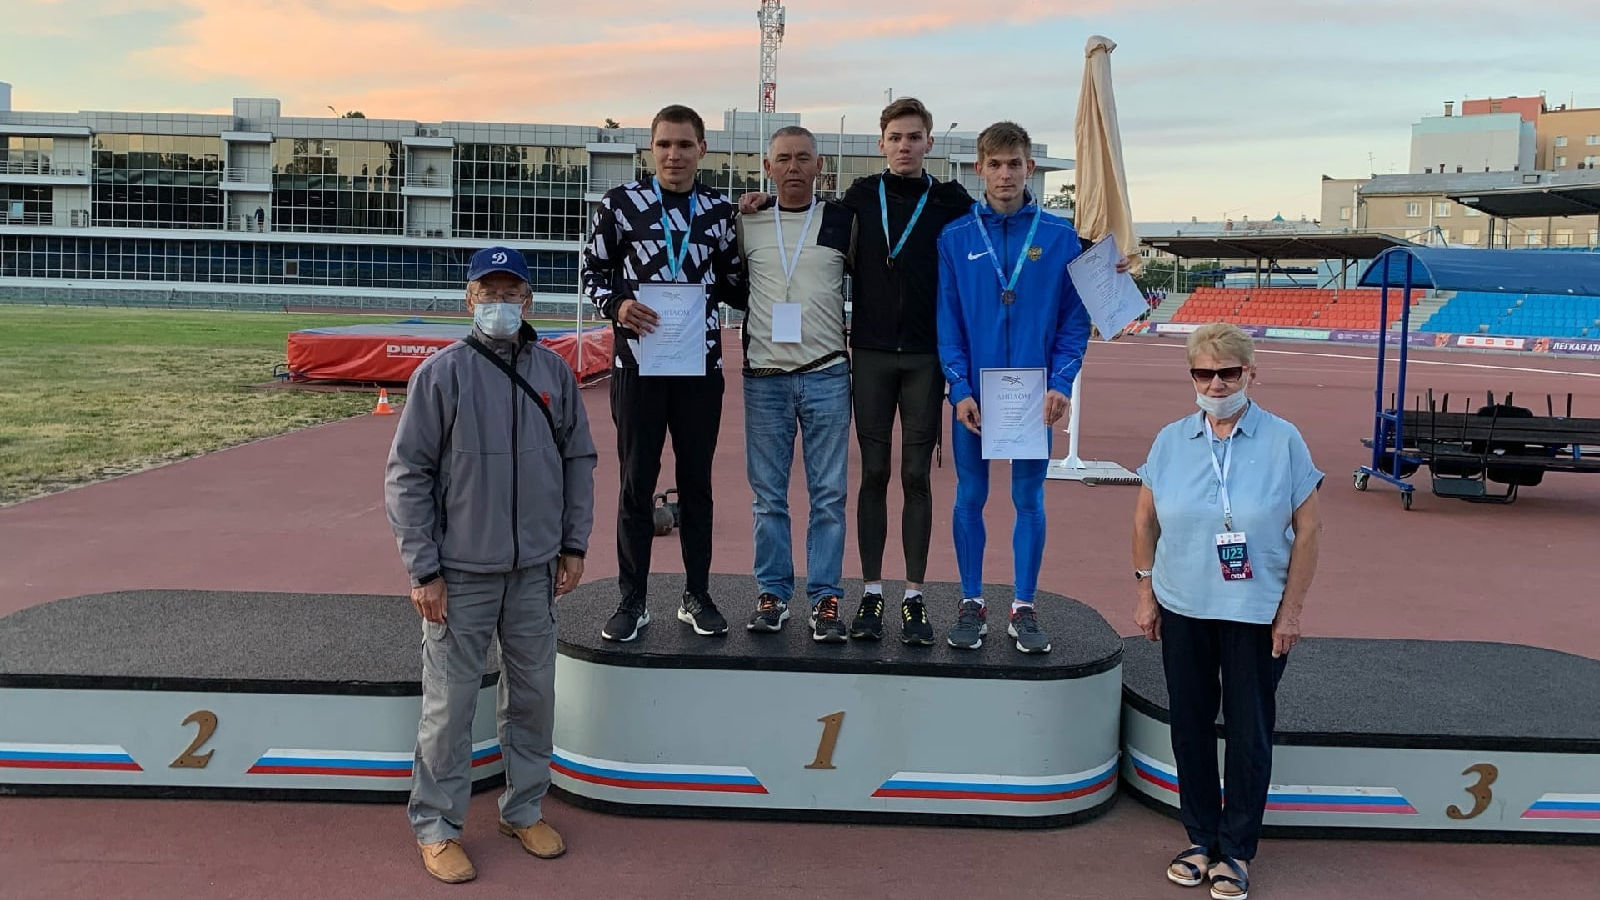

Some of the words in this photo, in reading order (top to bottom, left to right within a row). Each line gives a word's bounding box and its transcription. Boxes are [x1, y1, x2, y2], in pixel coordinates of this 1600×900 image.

[1552, 342, 1587, 351] ЛЕГКАЯ
[1222, 547, 1244, 560] U23
[168, 710, 218, 769] 2
[804, 711, 846, 769] 1
[1446, 763, 1499, 820] 3
